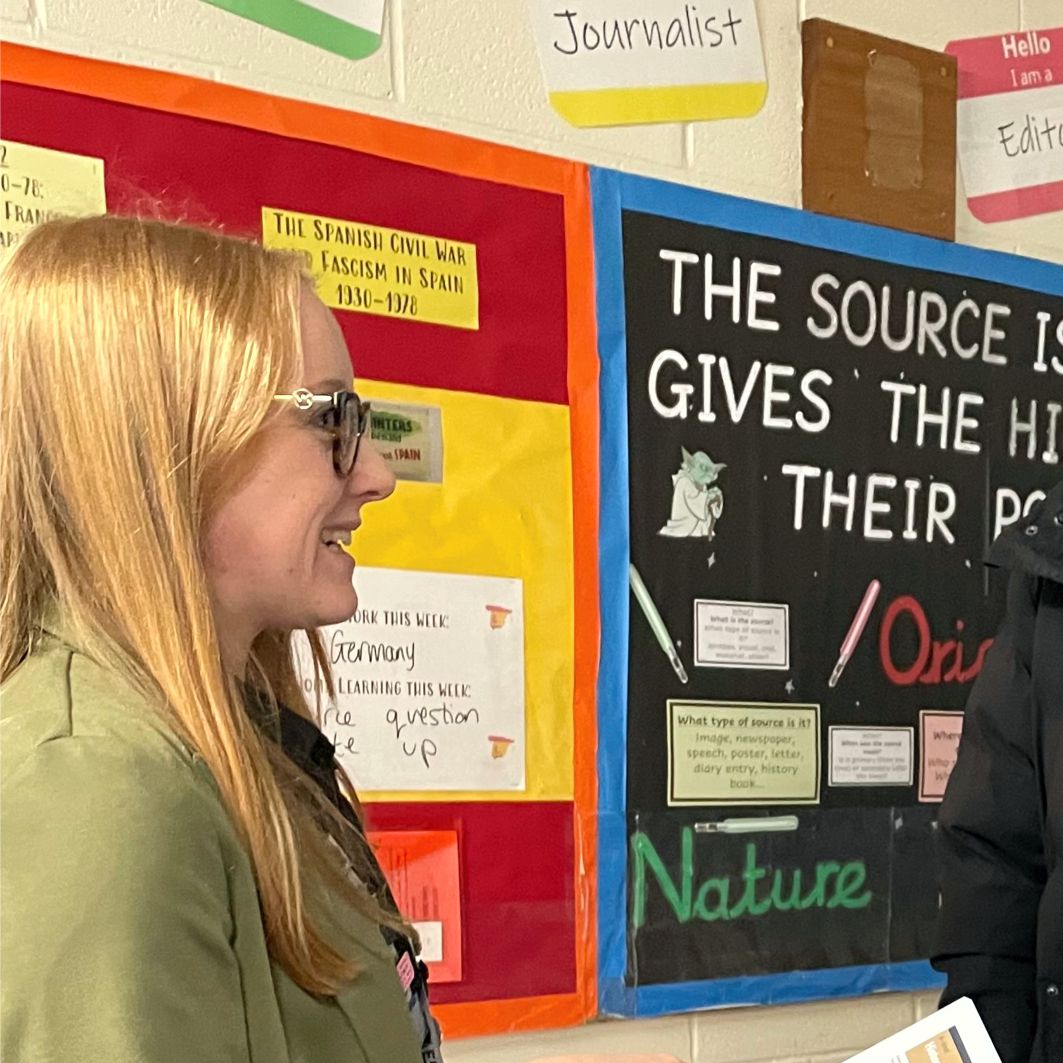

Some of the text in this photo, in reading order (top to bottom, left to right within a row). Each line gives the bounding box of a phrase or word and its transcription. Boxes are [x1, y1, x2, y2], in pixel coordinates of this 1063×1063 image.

[553, 5, 743, 55] Journalist
[1001, 31, 1051, 59] Hello
[1010, 68, 1053, 87] I am a
[273, 212, 466, 266] THE SPANISH CIVIL WAR
[321, 250, 387, 282] FASCISM
[396, 265, 412, 285] IN
[420, 267, 464, 294] SPAIN
[659, 248, 782, 332] THE
[806, 272, 1011, 366] SOURCE
[648, 348, 833, 433] GIVES
[880, 379, 984, 455] THE
[781, 464, 957, 545] THEIR
[384, 610, 411, 627] THIS
[416, 612, 450, 629] WEEK:
[330, 629, 415, 671] Germany
[338, 676, 402, 696] LEARNING
[406, 681, 434, 697] THIS
[439, 683, 472, 699] WEEK:
[386, 702, 480, 740] question
[677, 715, 812, 729] What type of source is it?
[402, 738, 437, 769] up
[693, 764, 722, 776] diary
[761, 764, 799, 776] history
[631, 826, 873, 928] Nature
